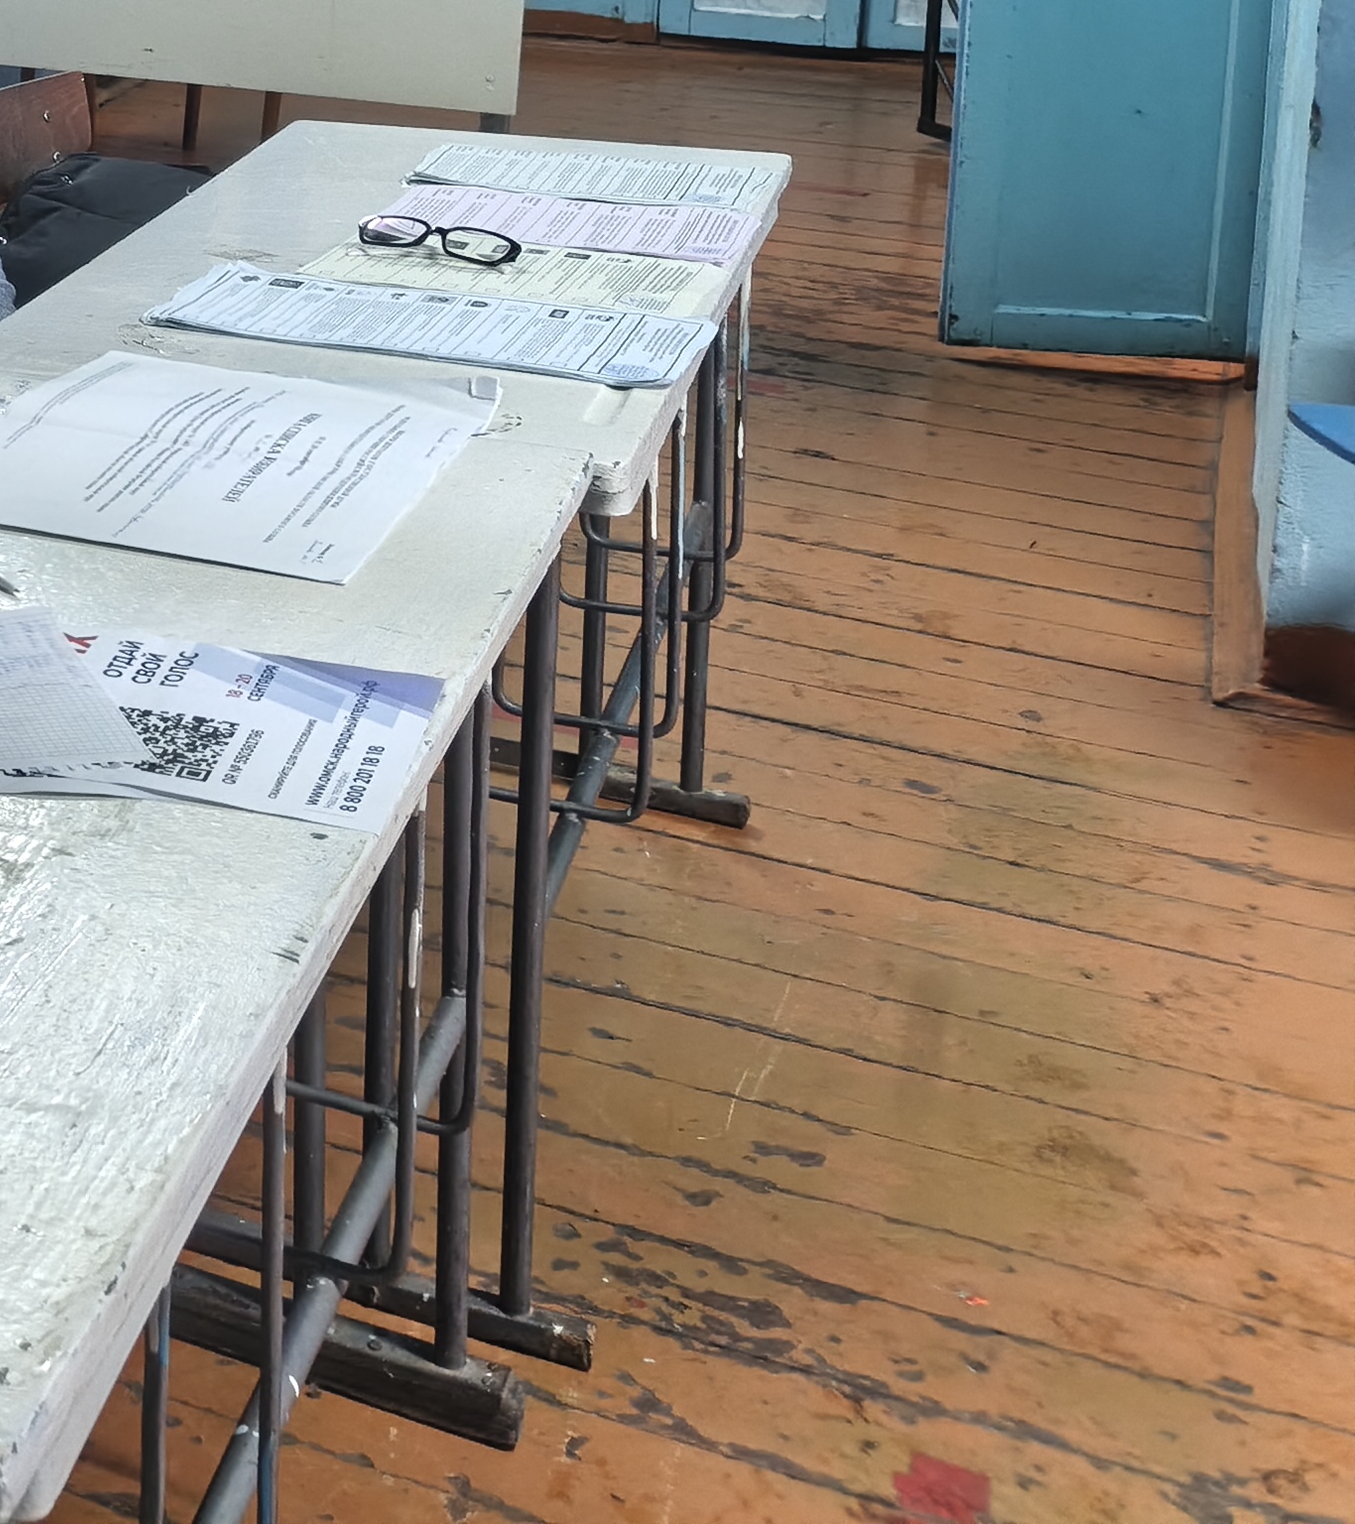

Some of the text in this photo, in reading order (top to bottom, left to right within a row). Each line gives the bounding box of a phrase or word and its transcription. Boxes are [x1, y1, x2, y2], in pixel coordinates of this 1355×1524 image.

[103, 640, 144, 678] ОТДАЙ
[131, 652, 167, 684] СВОЙ
[159, 651, 199, 687] ГОЛОС
[235, 673, 253, 684] 20
[247, 664, 280, 702] СЕНТЯБРЯ
[339, 745, 386, 812] 8 800 201 18 18
